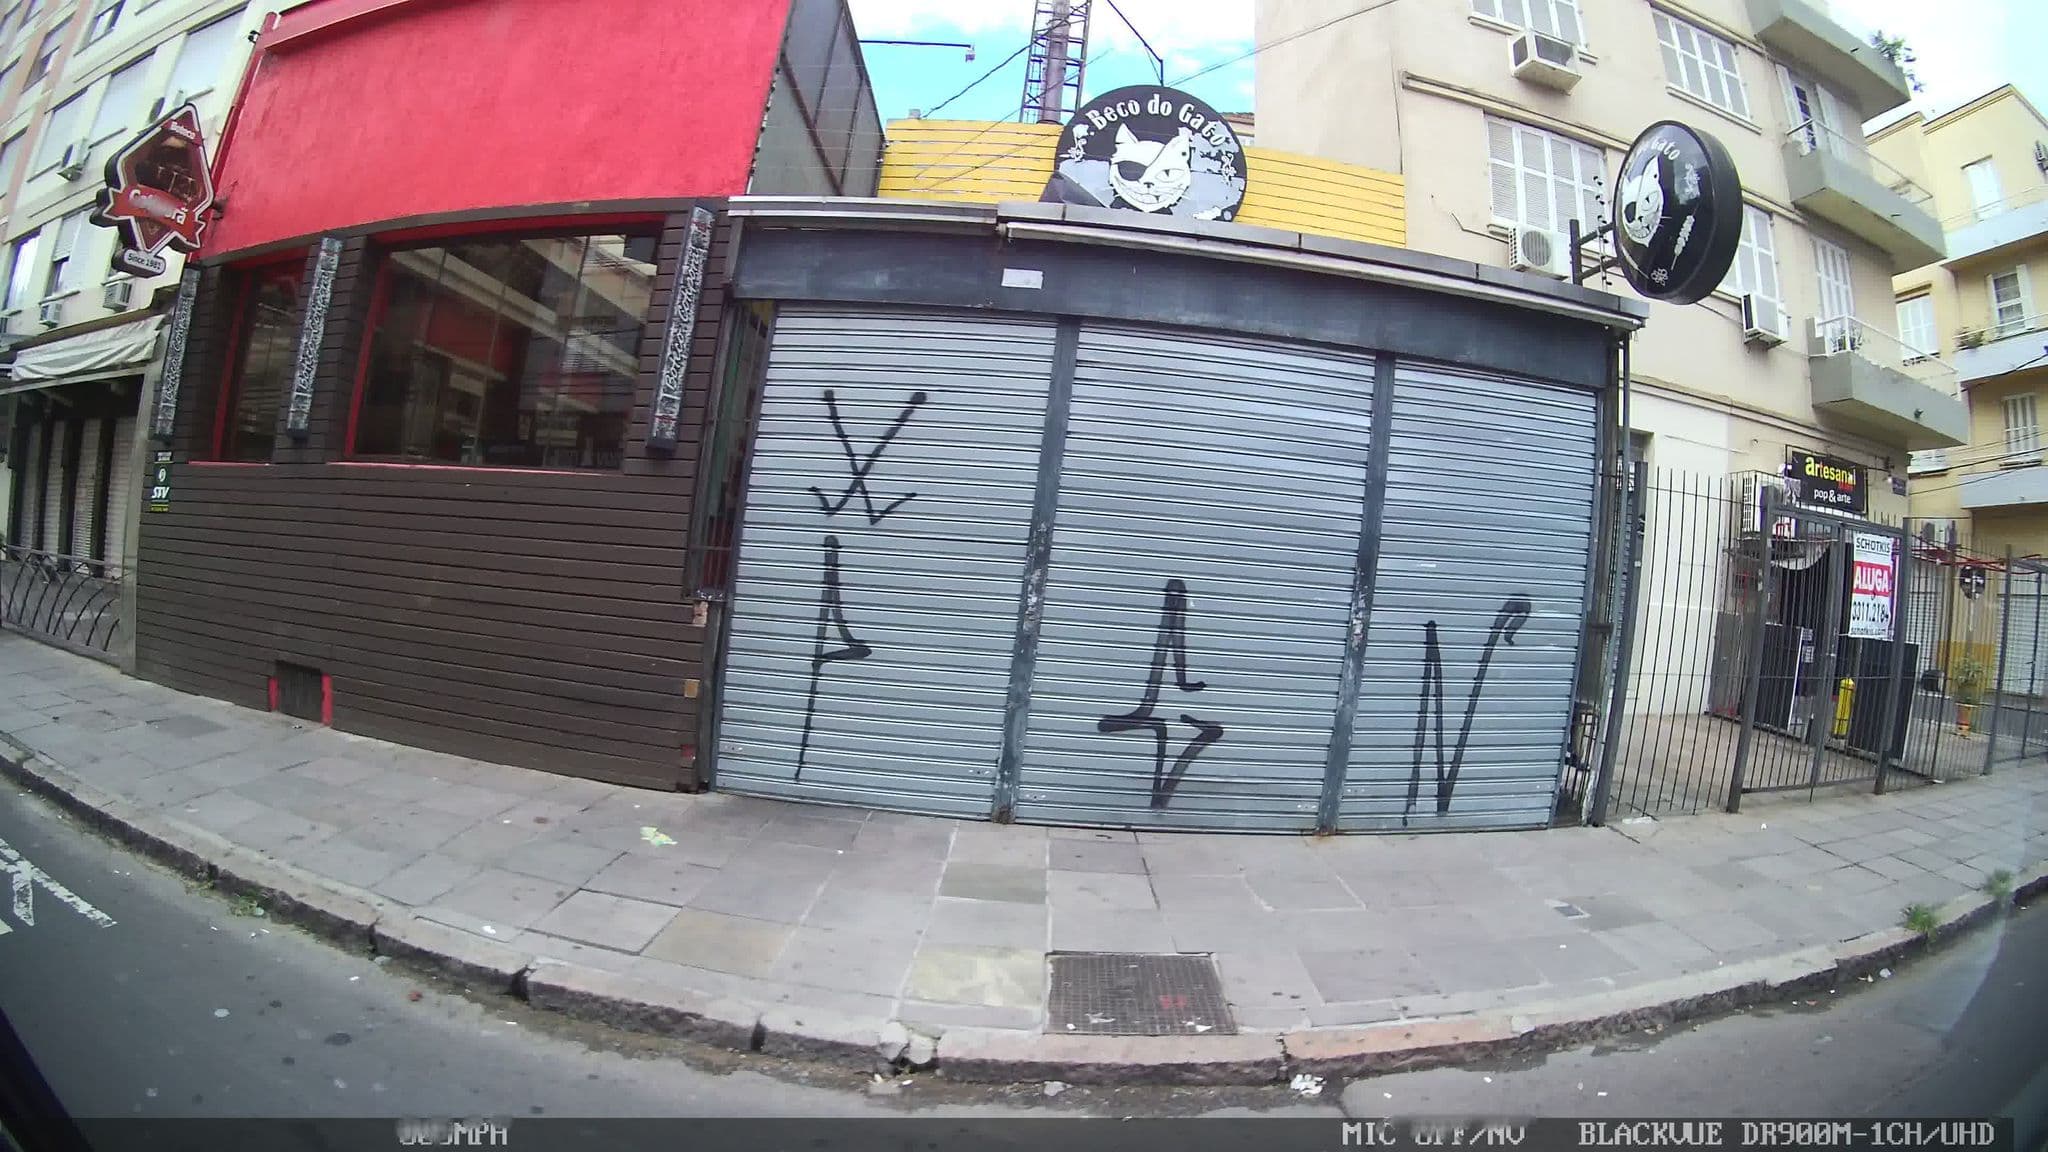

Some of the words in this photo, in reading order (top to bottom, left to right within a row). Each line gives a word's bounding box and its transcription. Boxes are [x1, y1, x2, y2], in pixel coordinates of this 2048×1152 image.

[1085, 99, 1140, 130] Beco
[1147, 93, 1173, 117] do
[1178, 102, 1228, 147] Gato
[127, 252, 145, 265] Since
[151, 486, 170, 499] STV
[1814, 489, 1829, 502] pop
[1828, 489, 1837, 504] &
[1836, 493, 1852, 504] arte
[1855, 537, 1891, 554] SCHOTKIS
[1853, 564, 1890, 594] ALUGA
